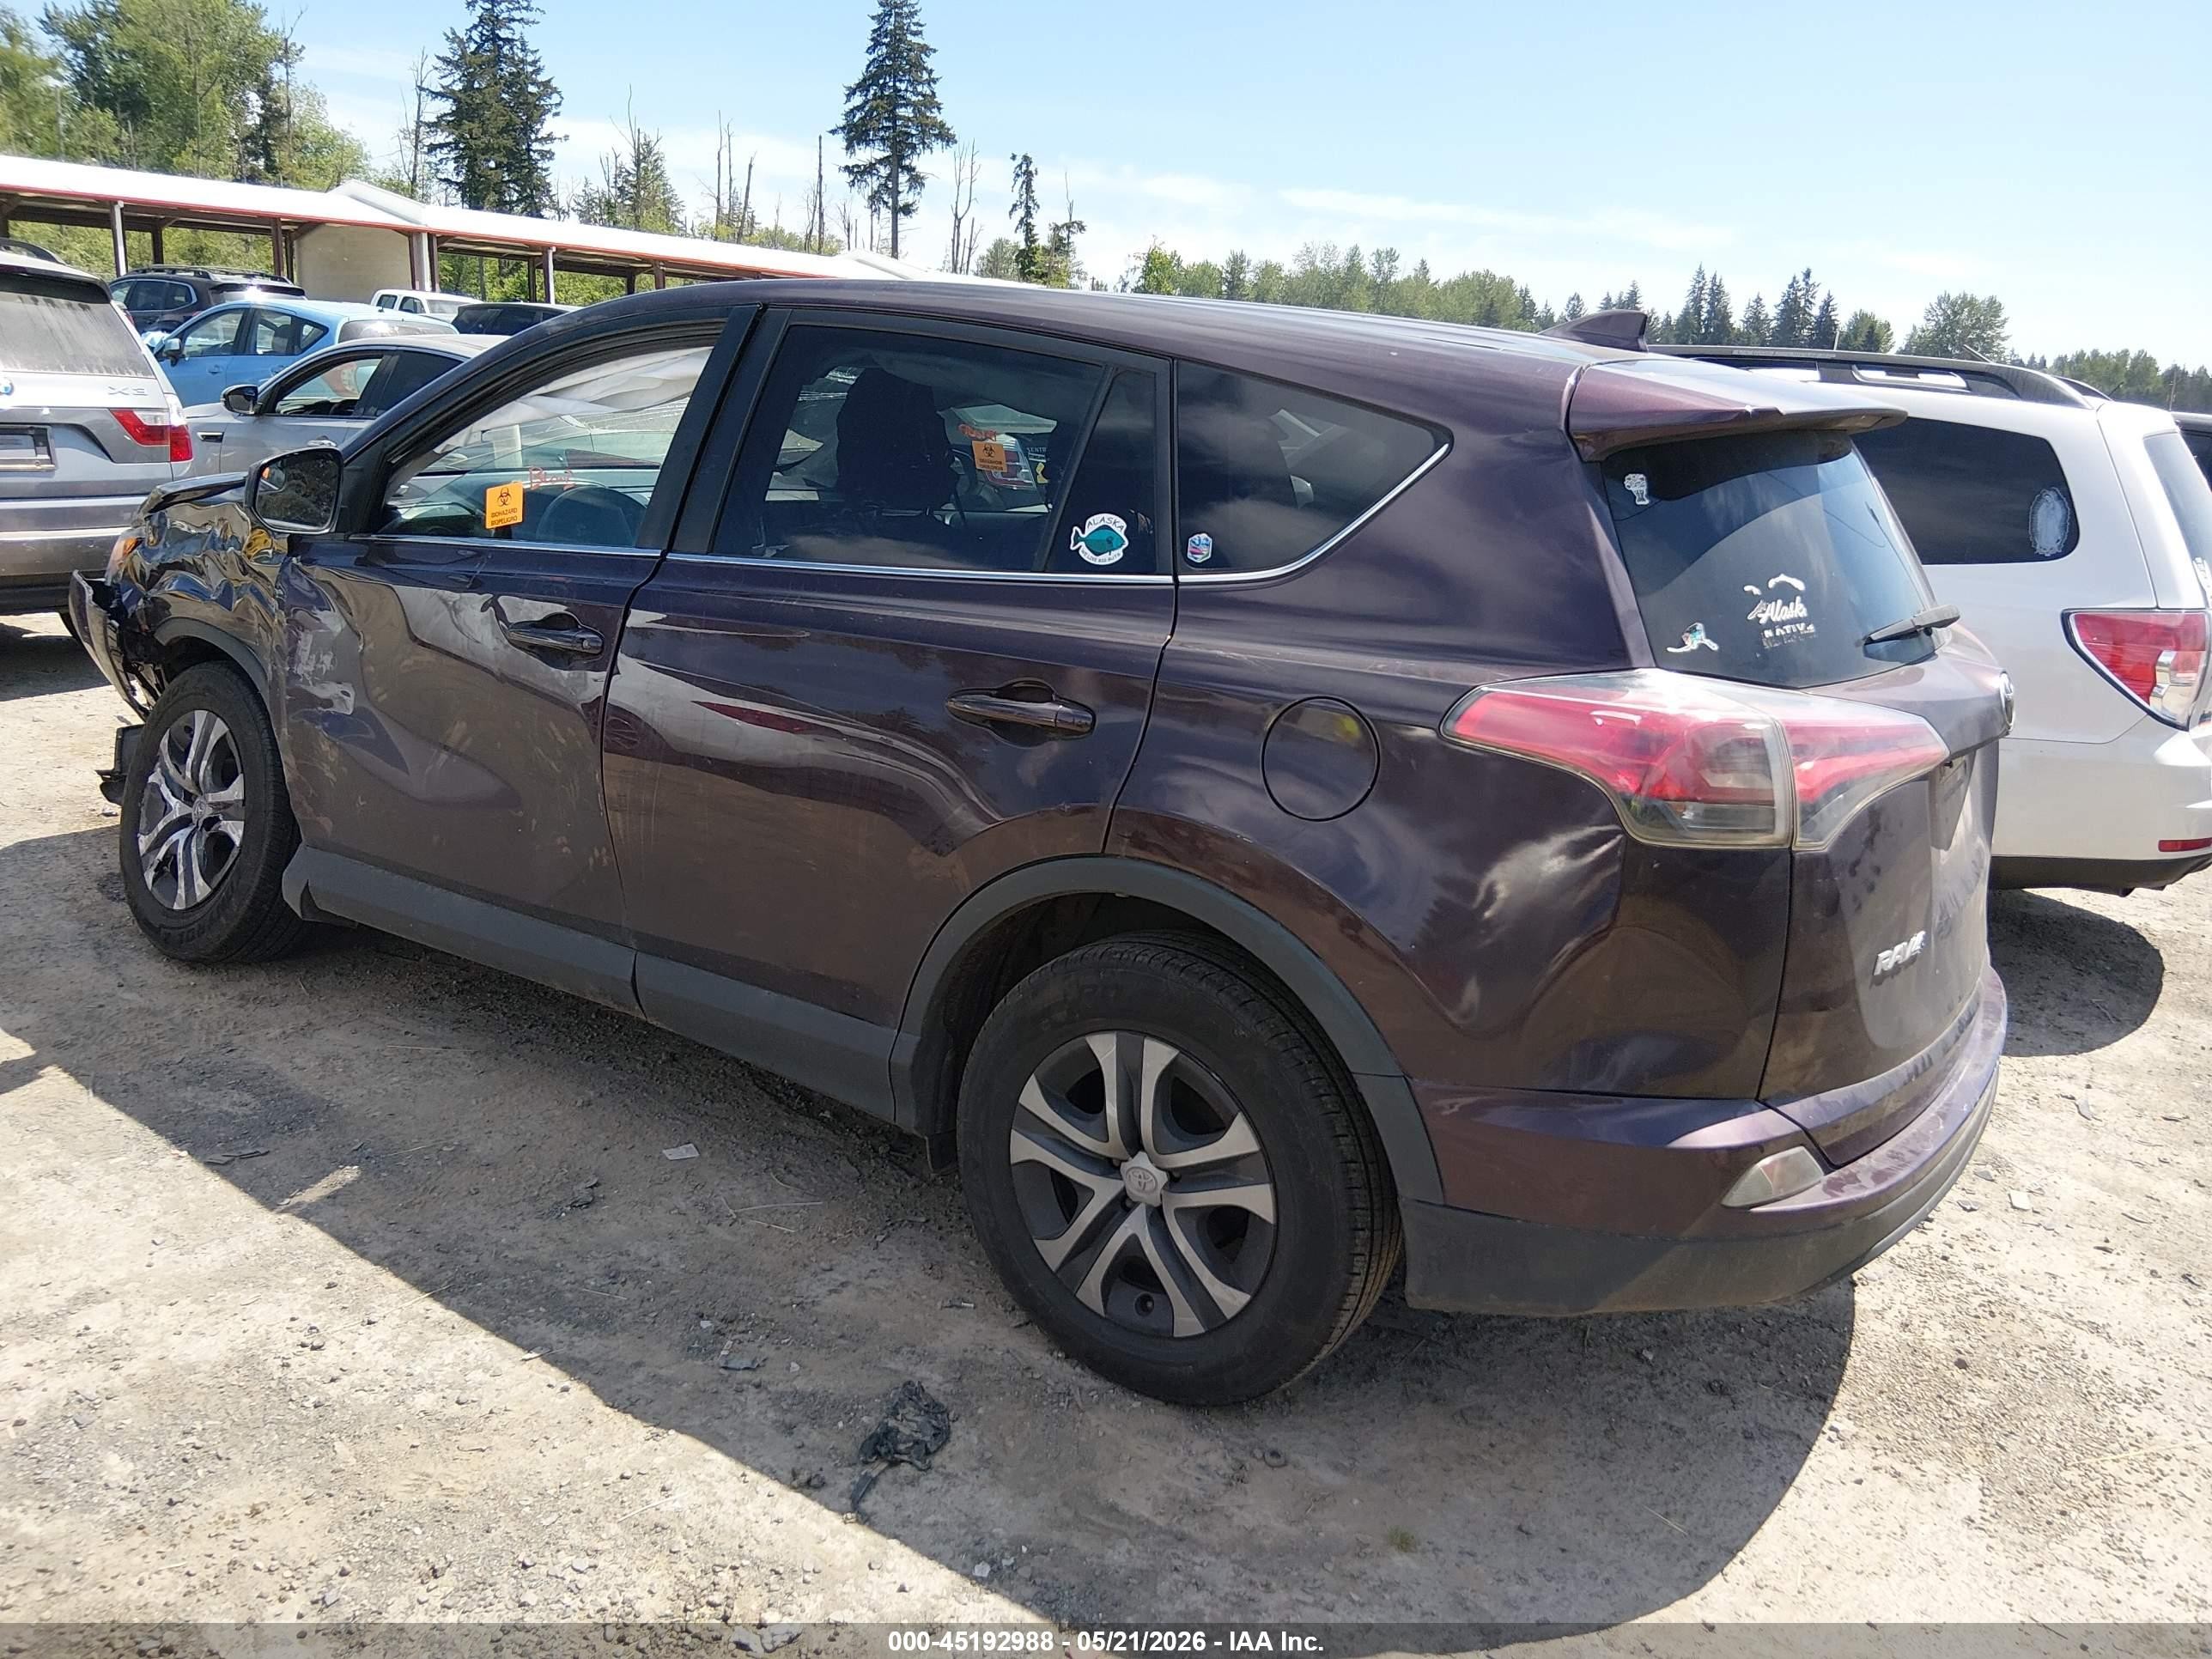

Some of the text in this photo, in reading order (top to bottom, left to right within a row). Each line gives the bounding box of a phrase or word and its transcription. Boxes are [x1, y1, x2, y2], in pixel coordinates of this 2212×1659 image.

[490, 508, 517, 518] BIOHAZARD
[490, 515, 517, 526] BIOPELIGRO
[1086, 516, 1125, 532] ALASKA
[1873, 930, 1926, 976] RAV4
